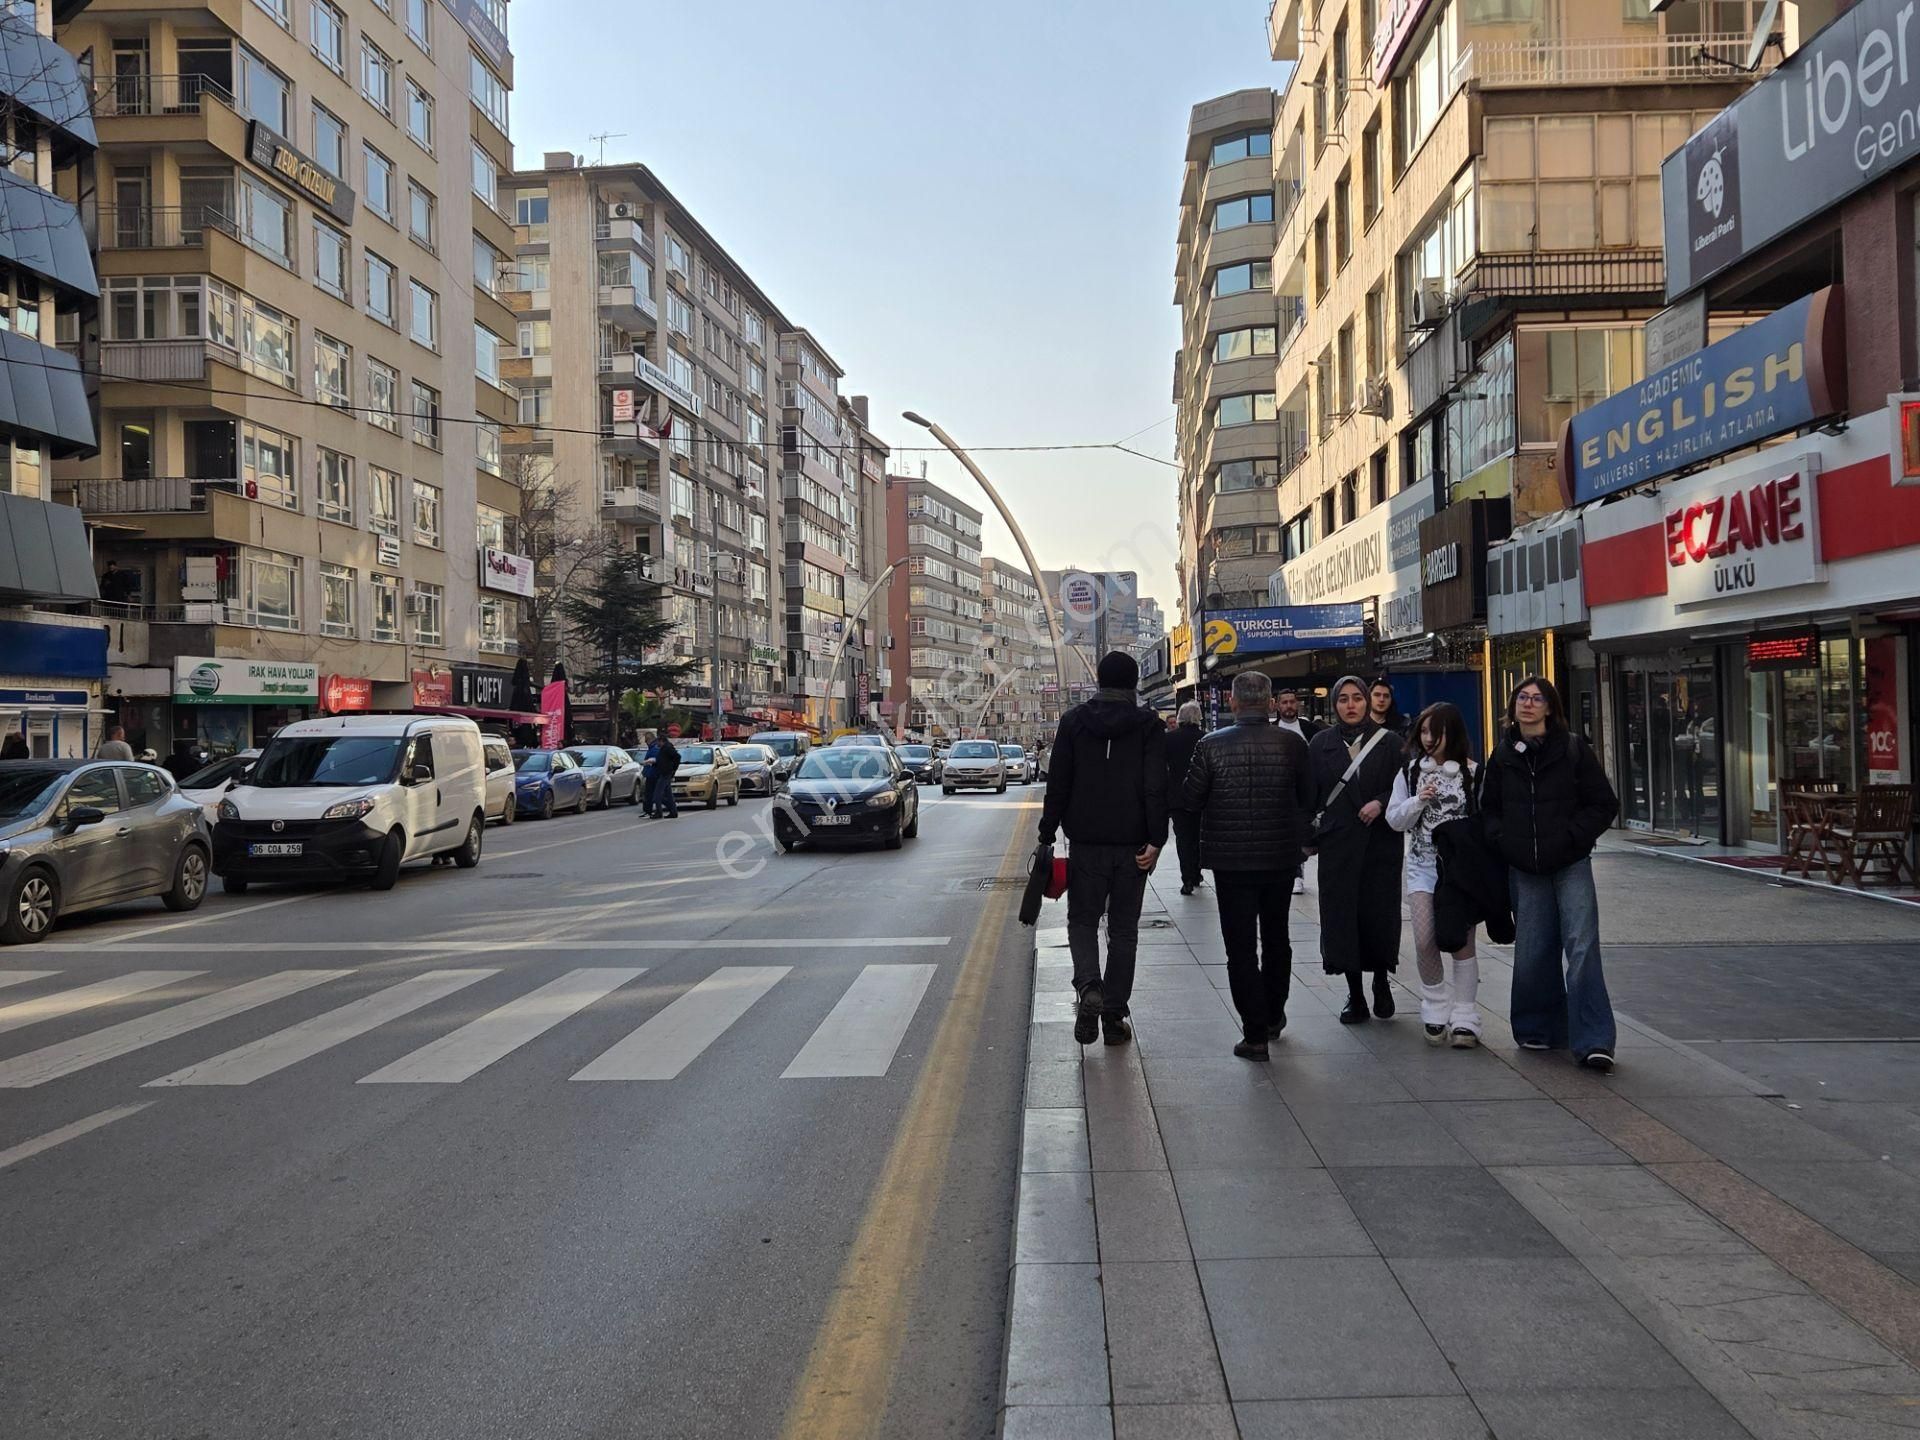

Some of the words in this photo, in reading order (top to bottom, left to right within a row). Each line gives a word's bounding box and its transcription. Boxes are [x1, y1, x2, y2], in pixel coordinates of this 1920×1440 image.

[1854, 104, 1920, 171] Gen
[1639, 358, 1703, 407] ACADEMIC
[1582, 342, 1804, 470] ENGLISH
[1656, 429, 1713, 465] HAZIRLIK
[1720, 405, 1776, 441] ATLAMA
[1665, 472, 1804, 567] ECZANE
[1325, 541, 1352, 596] GELİŞİM
[1352, 530, 1382, 583] KURSU
[1714, 558, 1756, 593] ÜLKÜ
[1234, 619, 1293, 631] TURKCELL
[1246, 629, 1294, 639] SUPERONLINE
[248, 666, 267, 678] IRAK
[267, 667, 287, 679] HAVA
[288, 668, 315, 680] YOLLARI
[477, 676, 503, 703] COFFY
[253, 845, 264, 854] 06
[286, 844, 301, 854] 259
